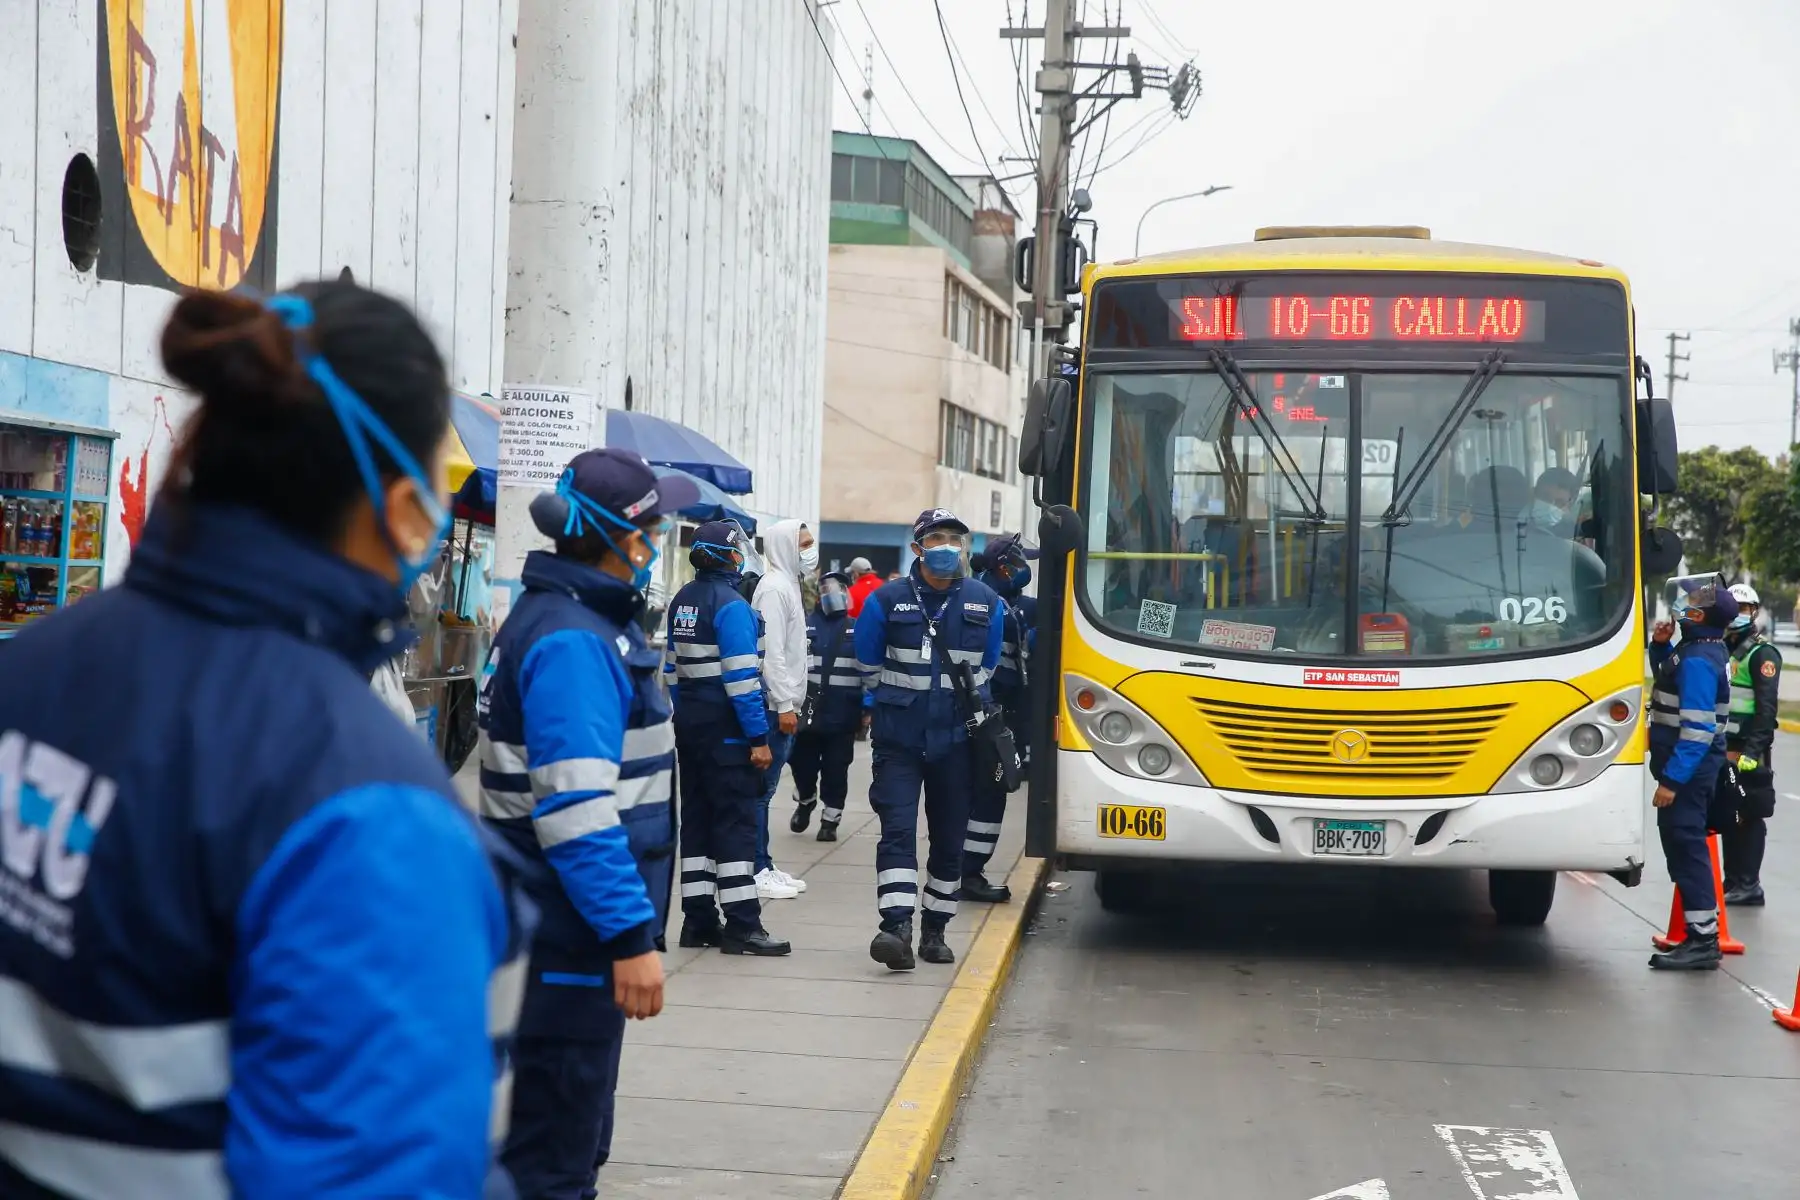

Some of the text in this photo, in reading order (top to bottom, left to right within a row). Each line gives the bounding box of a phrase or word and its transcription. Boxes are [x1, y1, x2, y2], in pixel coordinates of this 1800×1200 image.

[126, 17, 245, 288] RATA
[1274, 297, 1369, 335] 10-66
[1394, 297, 1522, 335] CALLAO
[511, 391, 570, 403] ALQUILAN
[549, 440, 586, 449] MASCOTAS
[532, 460, 554, 468] AGUA
[893, 603, 911, 612] ATU
[1499, 596, 1567, 625] 026
[1304, 671, 1399, 683] ETP SAN SEBASTIÁN
[1100, 806, 1163, 837] 10-66
[1316, 829, 1381, 849] BBK-709
